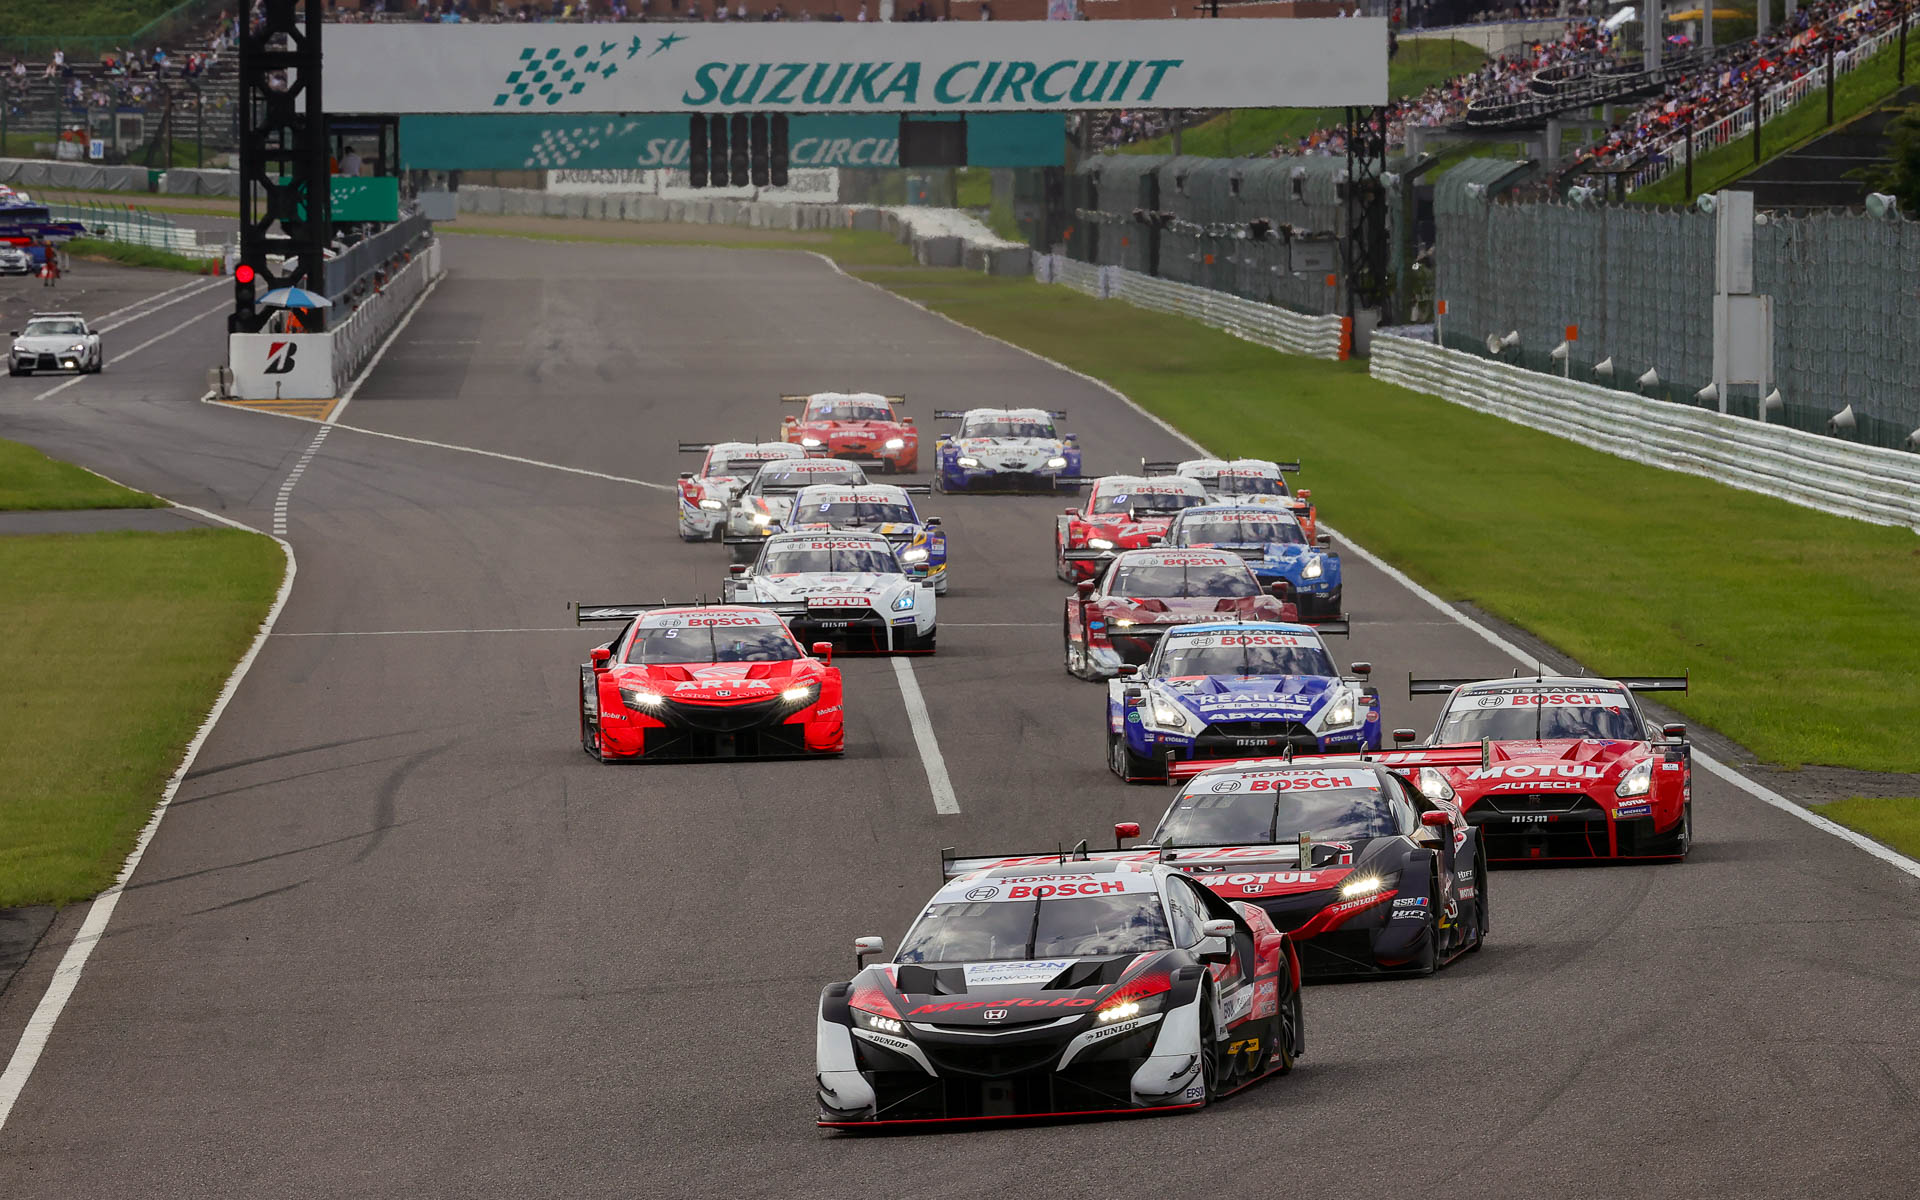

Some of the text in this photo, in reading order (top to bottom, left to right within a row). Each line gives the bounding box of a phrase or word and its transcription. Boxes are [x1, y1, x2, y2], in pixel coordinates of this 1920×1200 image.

[683, 59, 1183, 106] SUZUKA CIRCUIT
[790, 138, 900, 165] CIRCU
[1163, 558, 1228, 566] BOSCH
[808, 597, 868, 605] MOTUL
[679, 611, 739, 619] HONDA
[687, 617, 760, 627] BOSCH
[1221, 636, 1298, 646] BOSCH
[675, 679, 772, 692] ARTA
[1200, 693, 1310, 706] REALIZE
[1511, 694, 1602, 706] BOSCH
[1208, 712, 1304, 720] ADVAN
[1236, 738, 1278, 747] nismo
[1240, 769, 1325, 780] HONDA
[1466, 764, 1606, 780] MOTUL
[1249, 776, 1353, 792] BOSCH
[1490, 781, 1582, 791] AUTECH
[1618, 798, 1647, 808] MOTUL
[1511, 814, 1559, 824] nismo
[998, 873, 1096, 885] HONDA
[1200, 872, 1318, 887] MOTUL
[1008, 880, 1126, 900] BOSCH
[1339, 895, 1378, 912] DUNLOP
[1392, 897, 1416, 908] SSR
[969, 962, 1067, 973] EPSON
[970, 974, 1052, 983] KENWOOD
[906, 997, 1096, 1016] Modulo
[1094, 1021, 1139, 1039] DUNLOP
[873, 1035, 908, 1049] DUNLOP
[1186, 1086, 1204, 1099] EPSO
